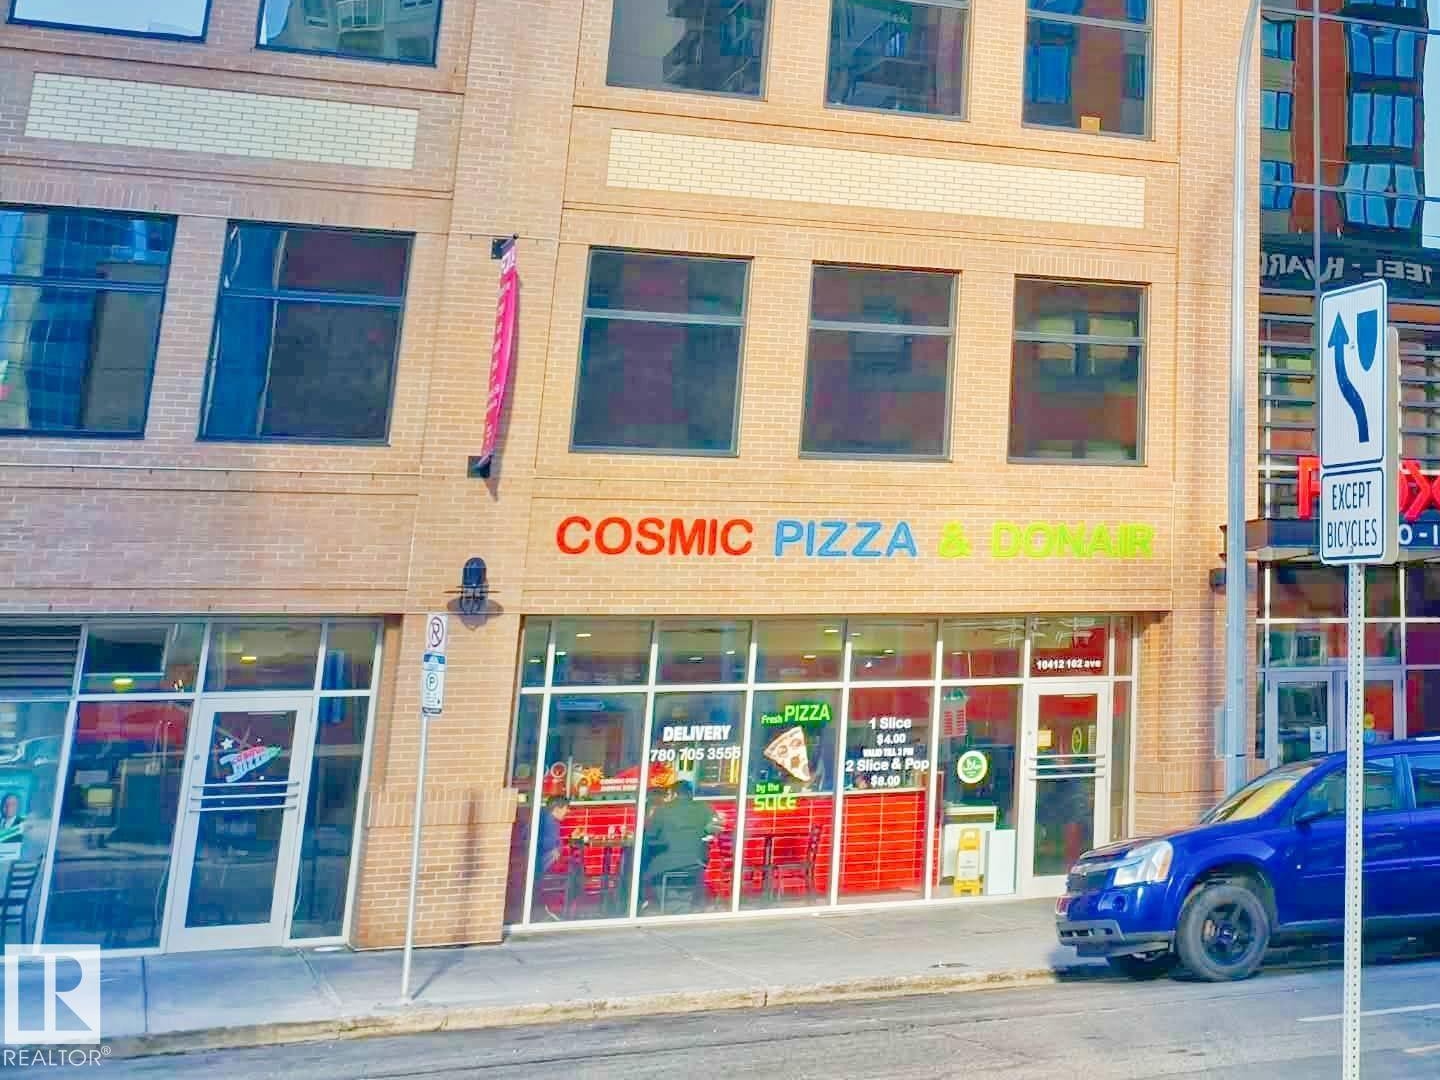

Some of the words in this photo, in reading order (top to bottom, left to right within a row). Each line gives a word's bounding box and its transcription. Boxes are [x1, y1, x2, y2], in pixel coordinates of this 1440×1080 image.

[1332, 481, 1371, 512] EXCEPT
[556, 516, 753, 556] COSMIC
[775, 519, 918, 558] PIZZA
[938, 520, 973, 559] &
[992, 521, 1155, 559] DONAIR
[1327, 518, 1377, 549] BICYCLES
[1036, 659, 1064, 670] 10412
[1066, 659, 1082, 669] 102
[1083, 660, 1101, 669] ave
[785, 704, 831, 722] PIZZA
[868, 717, 876, 729] 1
[879, 716, 912, 729] Slice
[663, 724, 731, 742] DELIVERY
[876, 733, 906, 746] $4.00
[650, 749, 675, 762] 780
[680, 748, 704, 760] 705
[845, 760, 854, 772] 2
[857, 758, 889, 771] Slice
[891, 758, 902, 770] &
[905, 758, 929, 772] Pop
